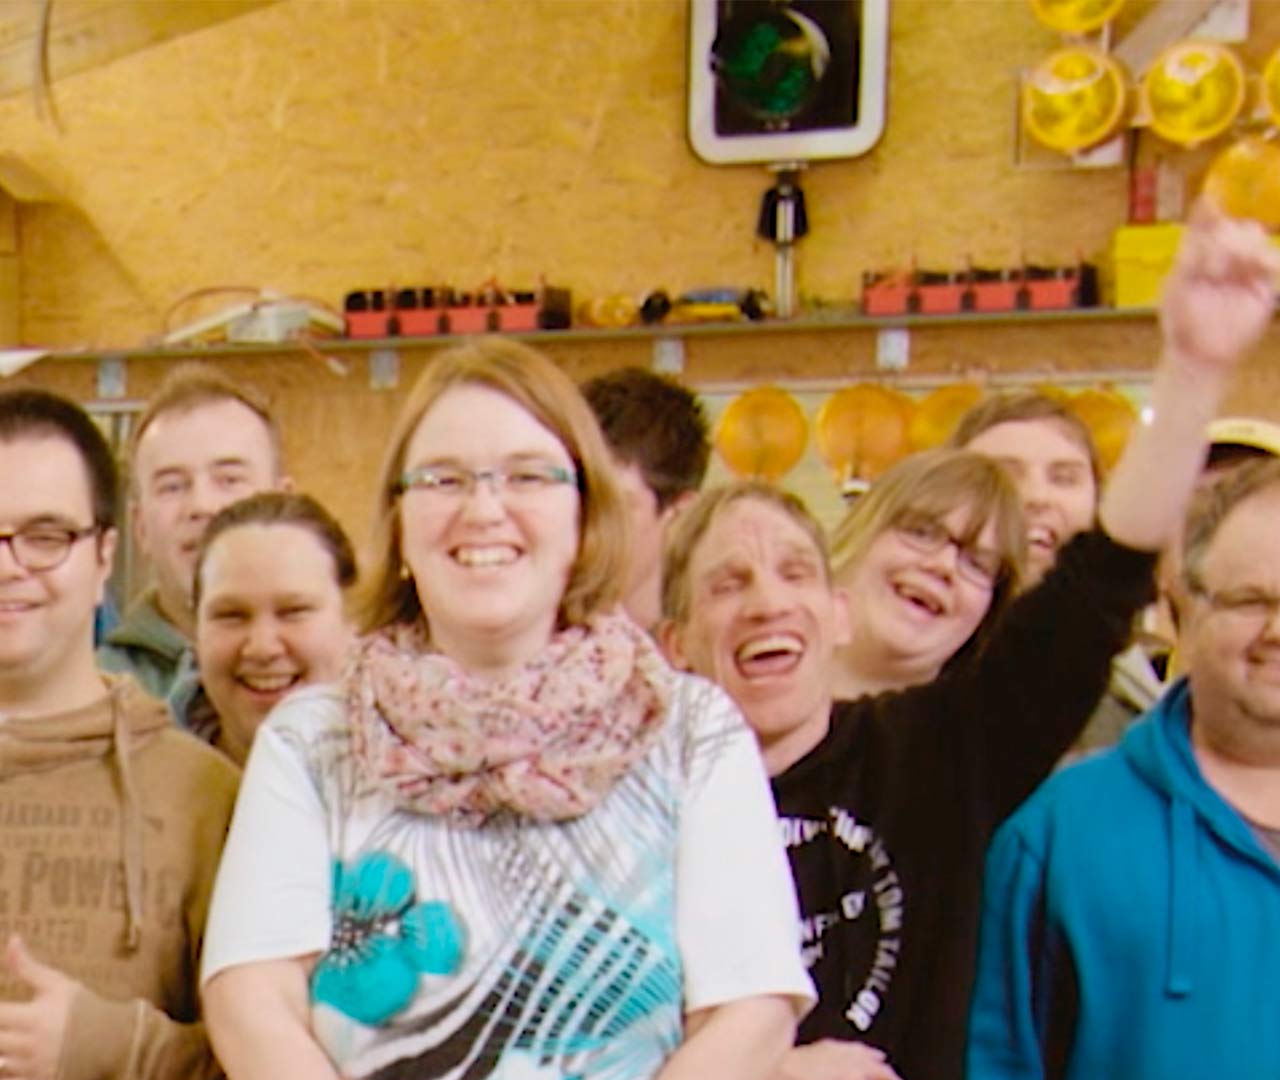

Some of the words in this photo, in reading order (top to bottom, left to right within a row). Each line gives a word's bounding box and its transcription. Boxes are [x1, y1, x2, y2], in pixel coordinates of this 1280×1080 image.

[19, 851, 148, 915] POWE
[873, 871, 903, 932] TOM
[845, 938, 902, 1032] TAILOR
